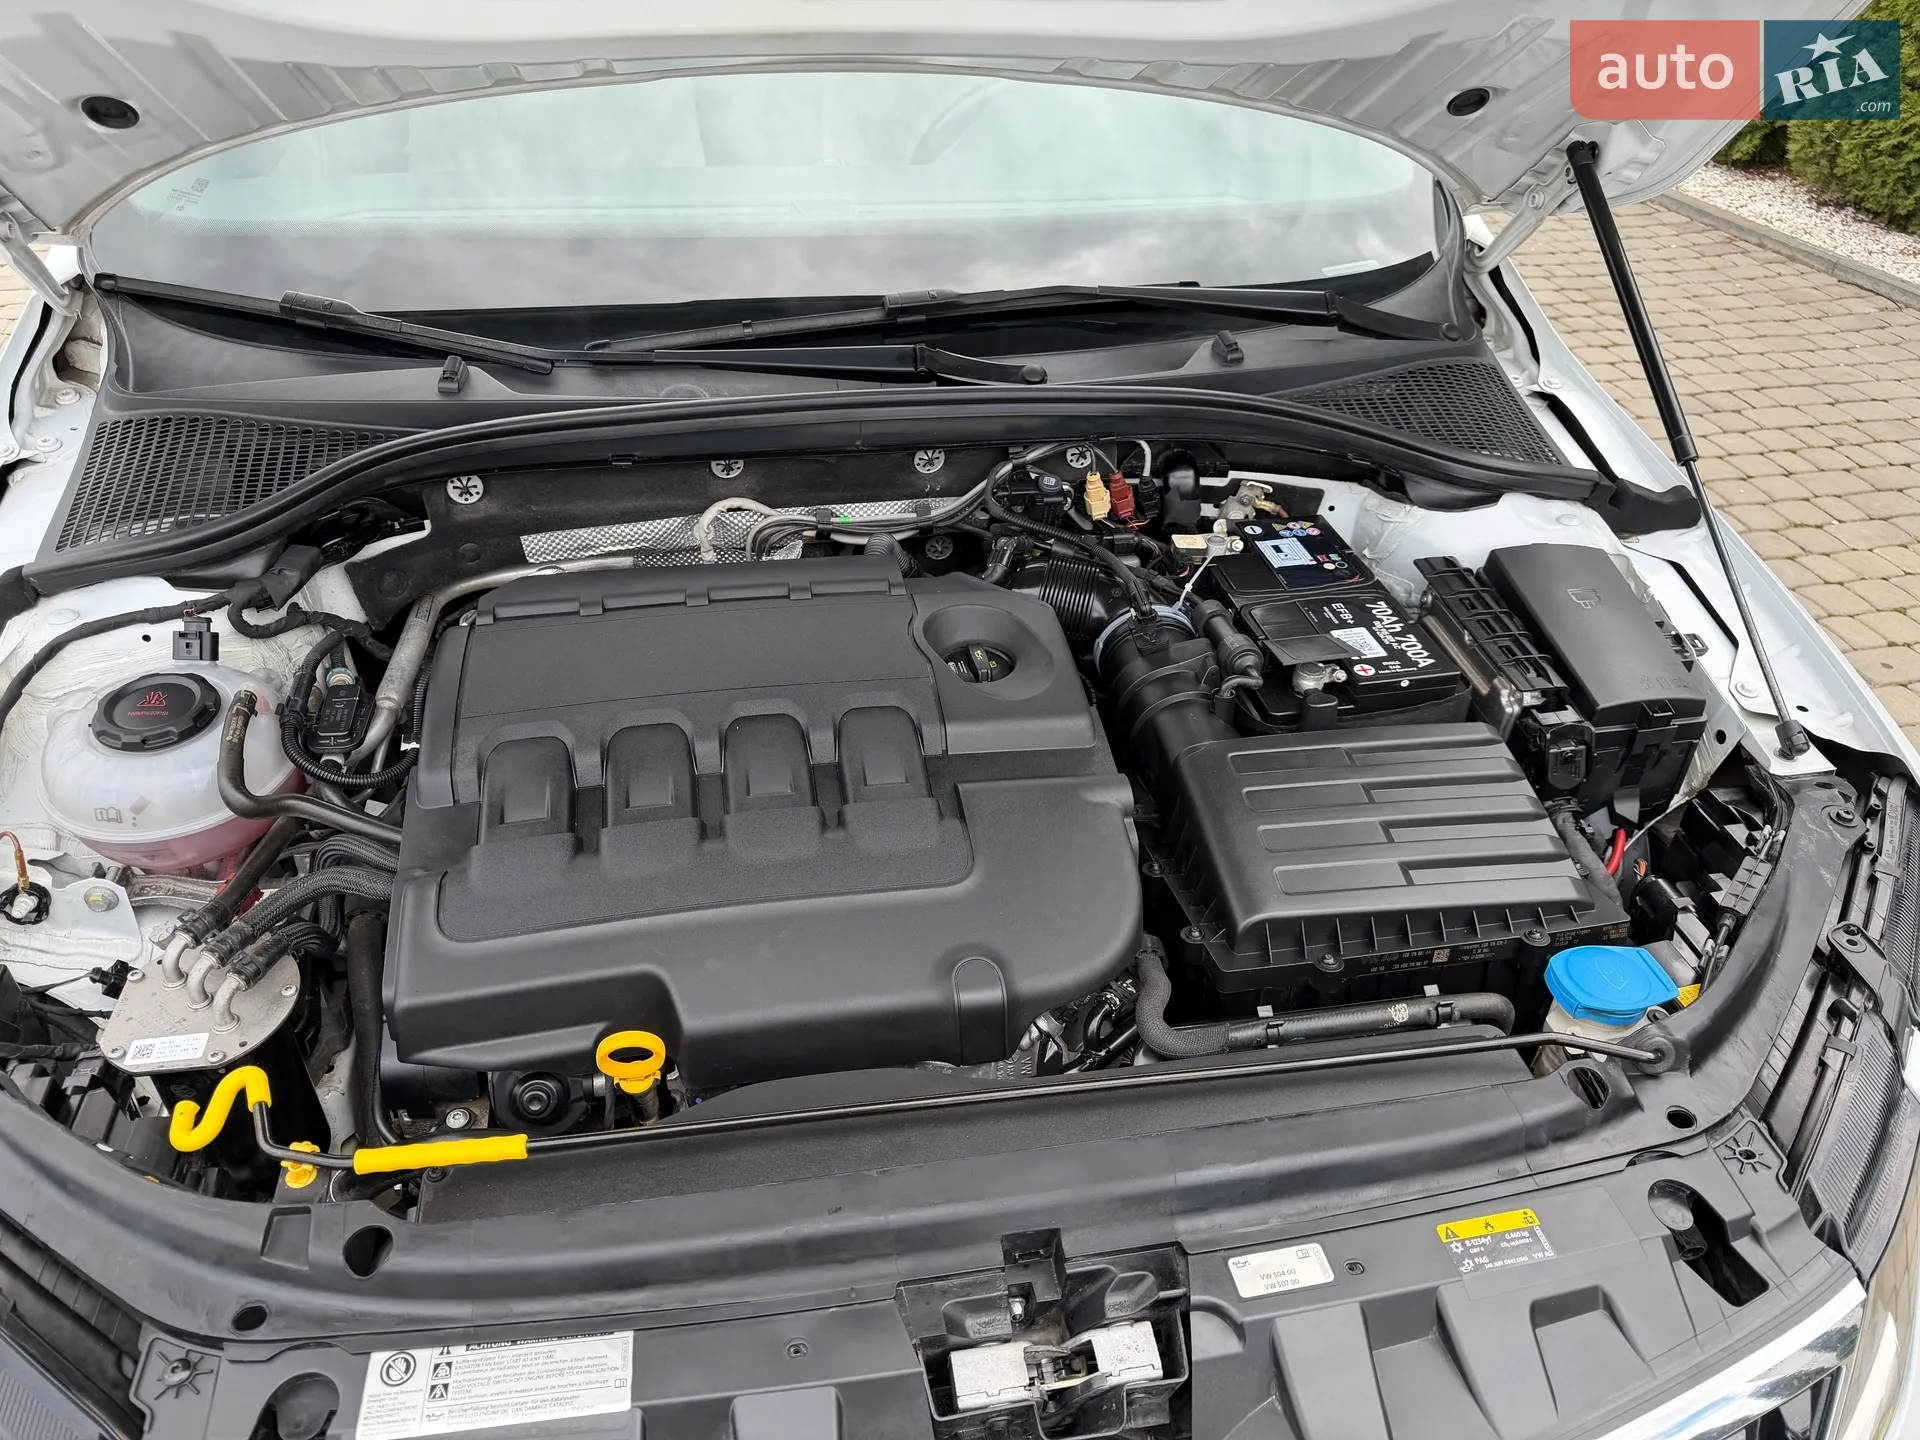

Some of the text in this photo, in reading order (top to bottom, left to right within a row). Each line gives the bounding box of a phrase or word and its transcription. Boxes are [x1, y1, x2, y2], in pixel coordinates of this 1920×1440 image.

[1332, 602, 1354, 624] EFB+
[1366, 601, 1404, 632] 70Ah
[1394, 634, 1436, 668] 700A
[1464, 1236, 1492, 1246] R-1234yf
[1474, 1256, 1489, 1265] PAG
[1532, 1252, 1543, 1260] VW
[1273, 1270, 1286, 1278] 504
[1264, 1282, 1276, 1290] VW
